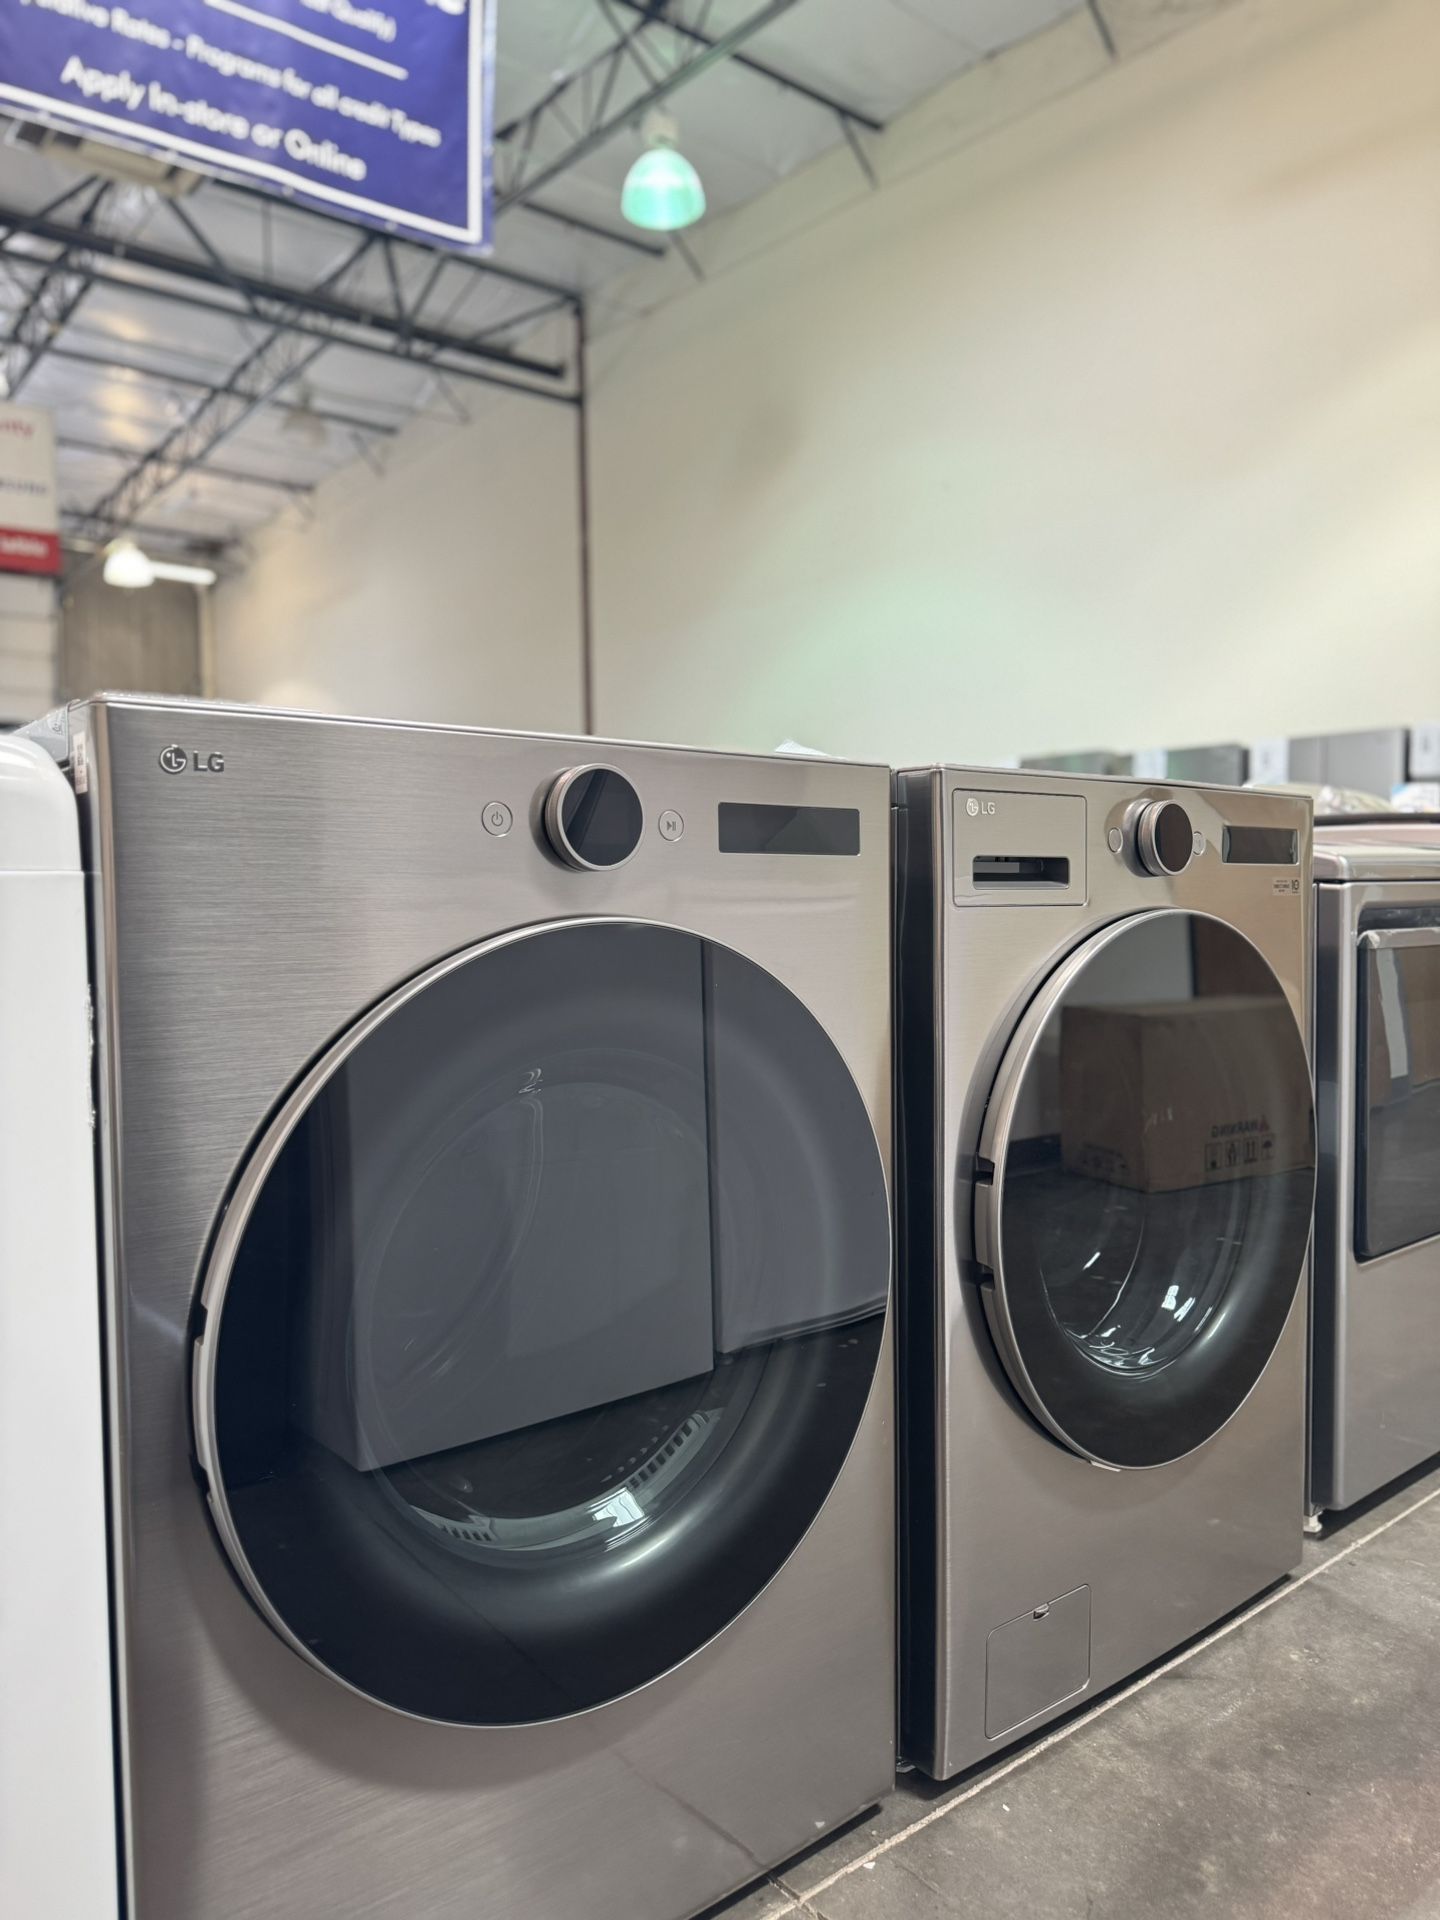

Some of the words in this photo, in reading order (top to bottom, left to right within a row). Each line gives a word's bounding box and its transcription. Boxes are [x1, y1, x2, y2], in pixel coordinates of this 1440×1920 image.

[186, 33, 283, 89] Programs
[282, 67, 312, 99] for
[60, 55, 146, 111] Apply
[149, 80, 250, 140] In-store
[251, 123, 284, 149] or
[284, 128, 367, 181] Online
[193, 751, 225, 773] LG
[981, 801, 996, 815] LG
